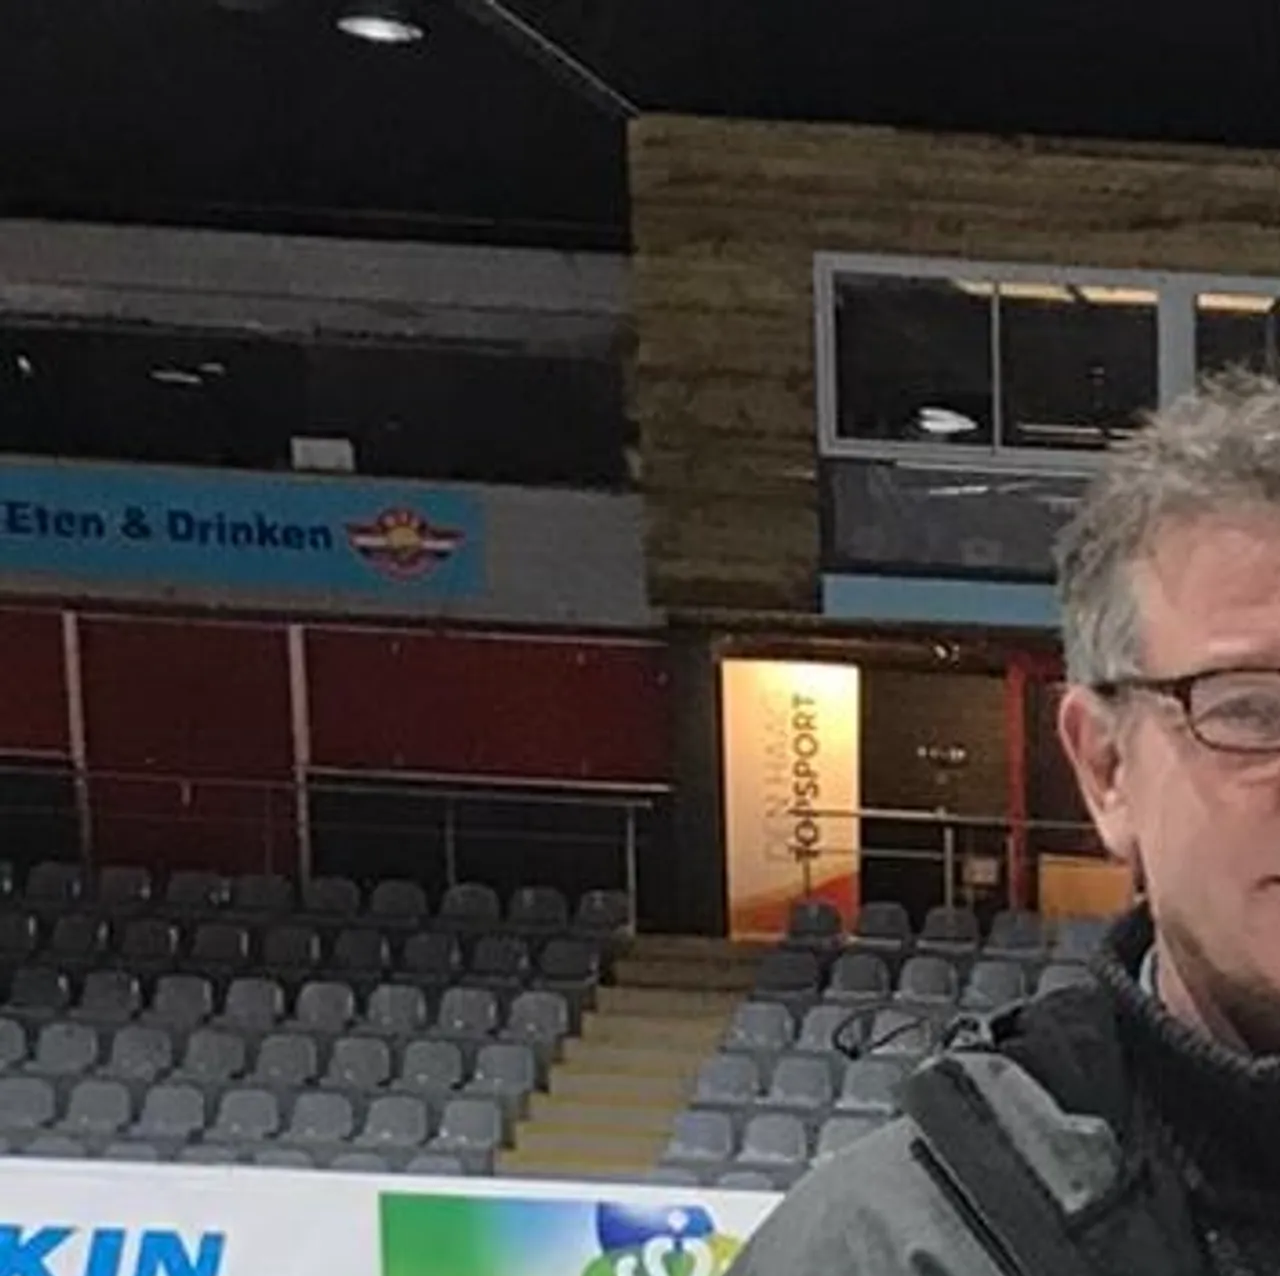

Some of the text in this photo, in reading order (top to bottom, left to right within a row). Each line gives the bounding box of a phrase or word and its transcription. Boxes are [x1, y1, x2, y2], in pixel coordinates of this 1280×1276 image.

[6, 501, 106, 538] Eten
[120, 505, 152, 539] &
[168, 510, 333, 549] Drinken
[791, 692, 820, 863] TOPSPORT
